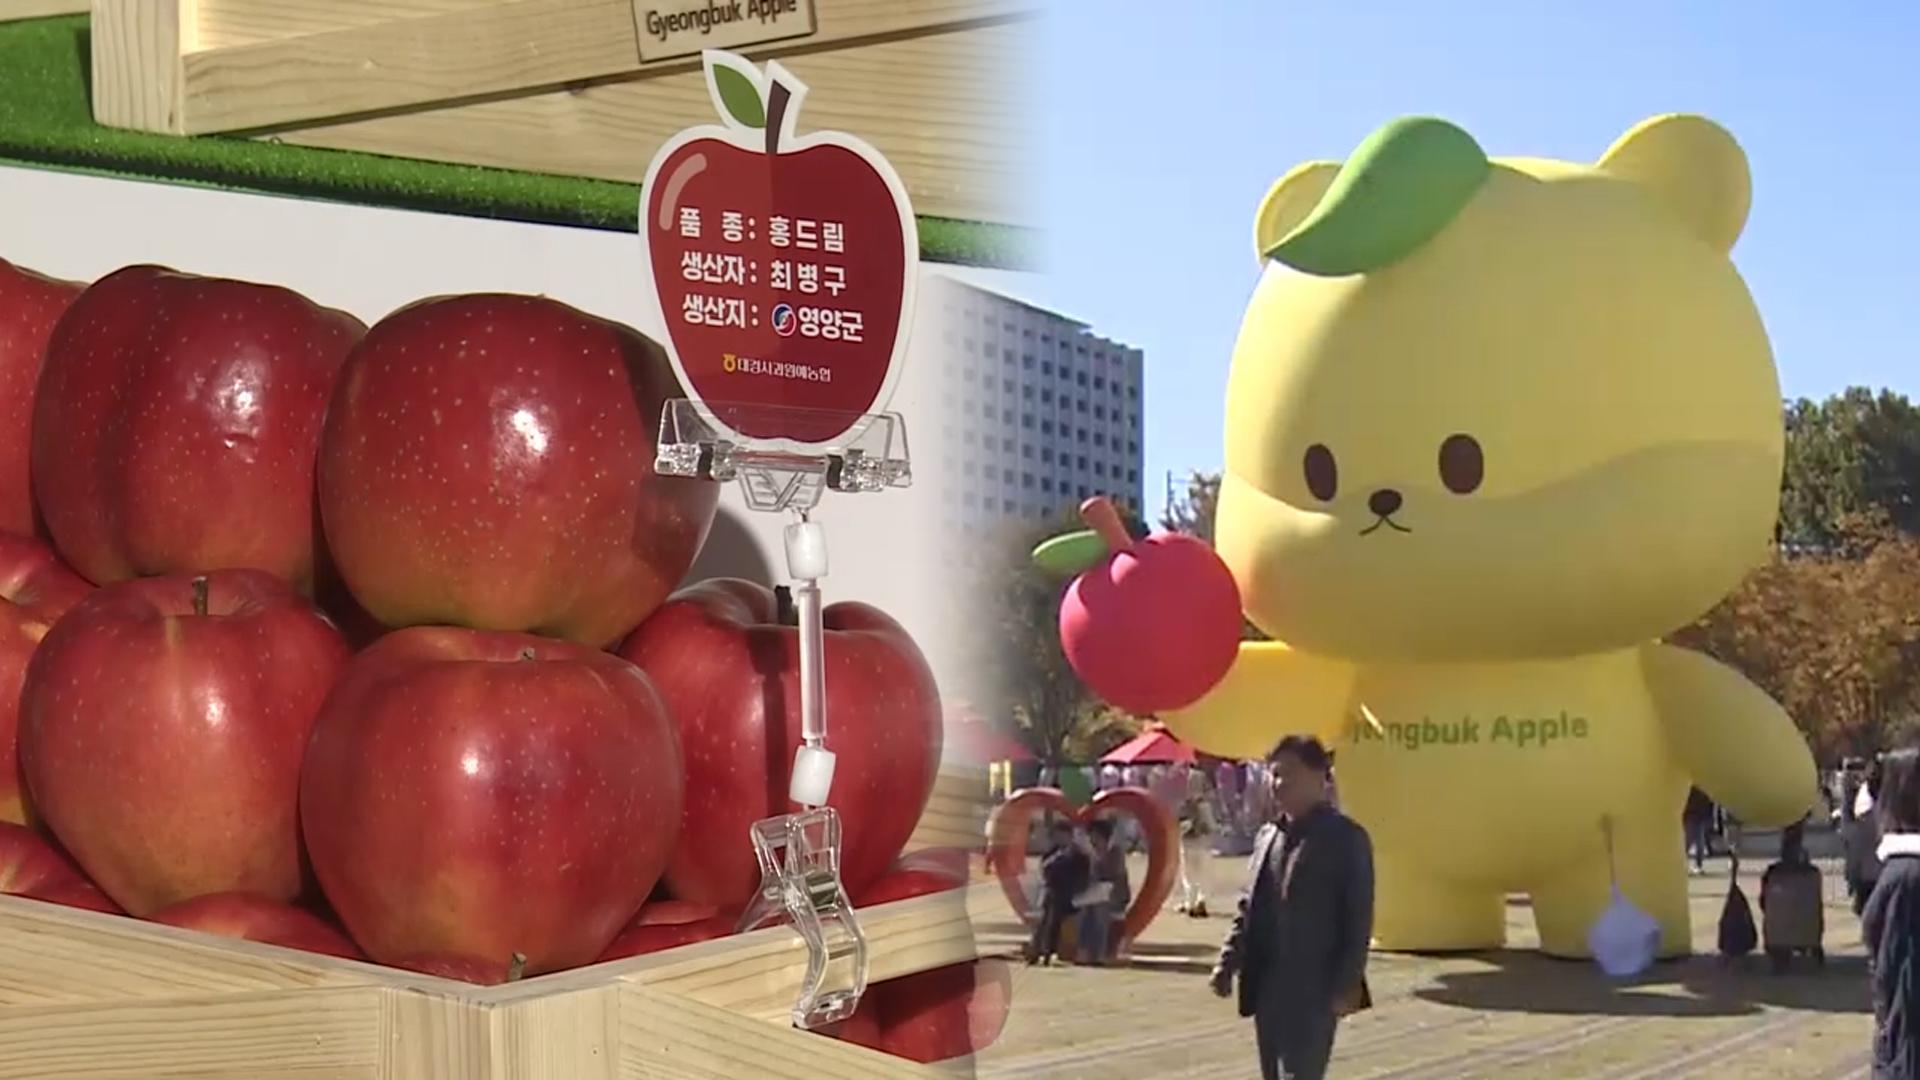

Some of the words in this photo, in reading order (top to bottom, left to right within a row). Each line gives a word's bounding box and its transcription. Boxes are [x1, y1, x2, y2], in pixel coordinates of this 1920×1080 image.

[646, 0, 743, 41] Gyeongbuk
[680, 207, 701, 238] 품
[681, 251, 758, 285] 생산자:
[682, 294, 759, 329] 생산지:
[798, 306, 864, 342] 영양군
[1491, 711, 1589, 747] Apple
